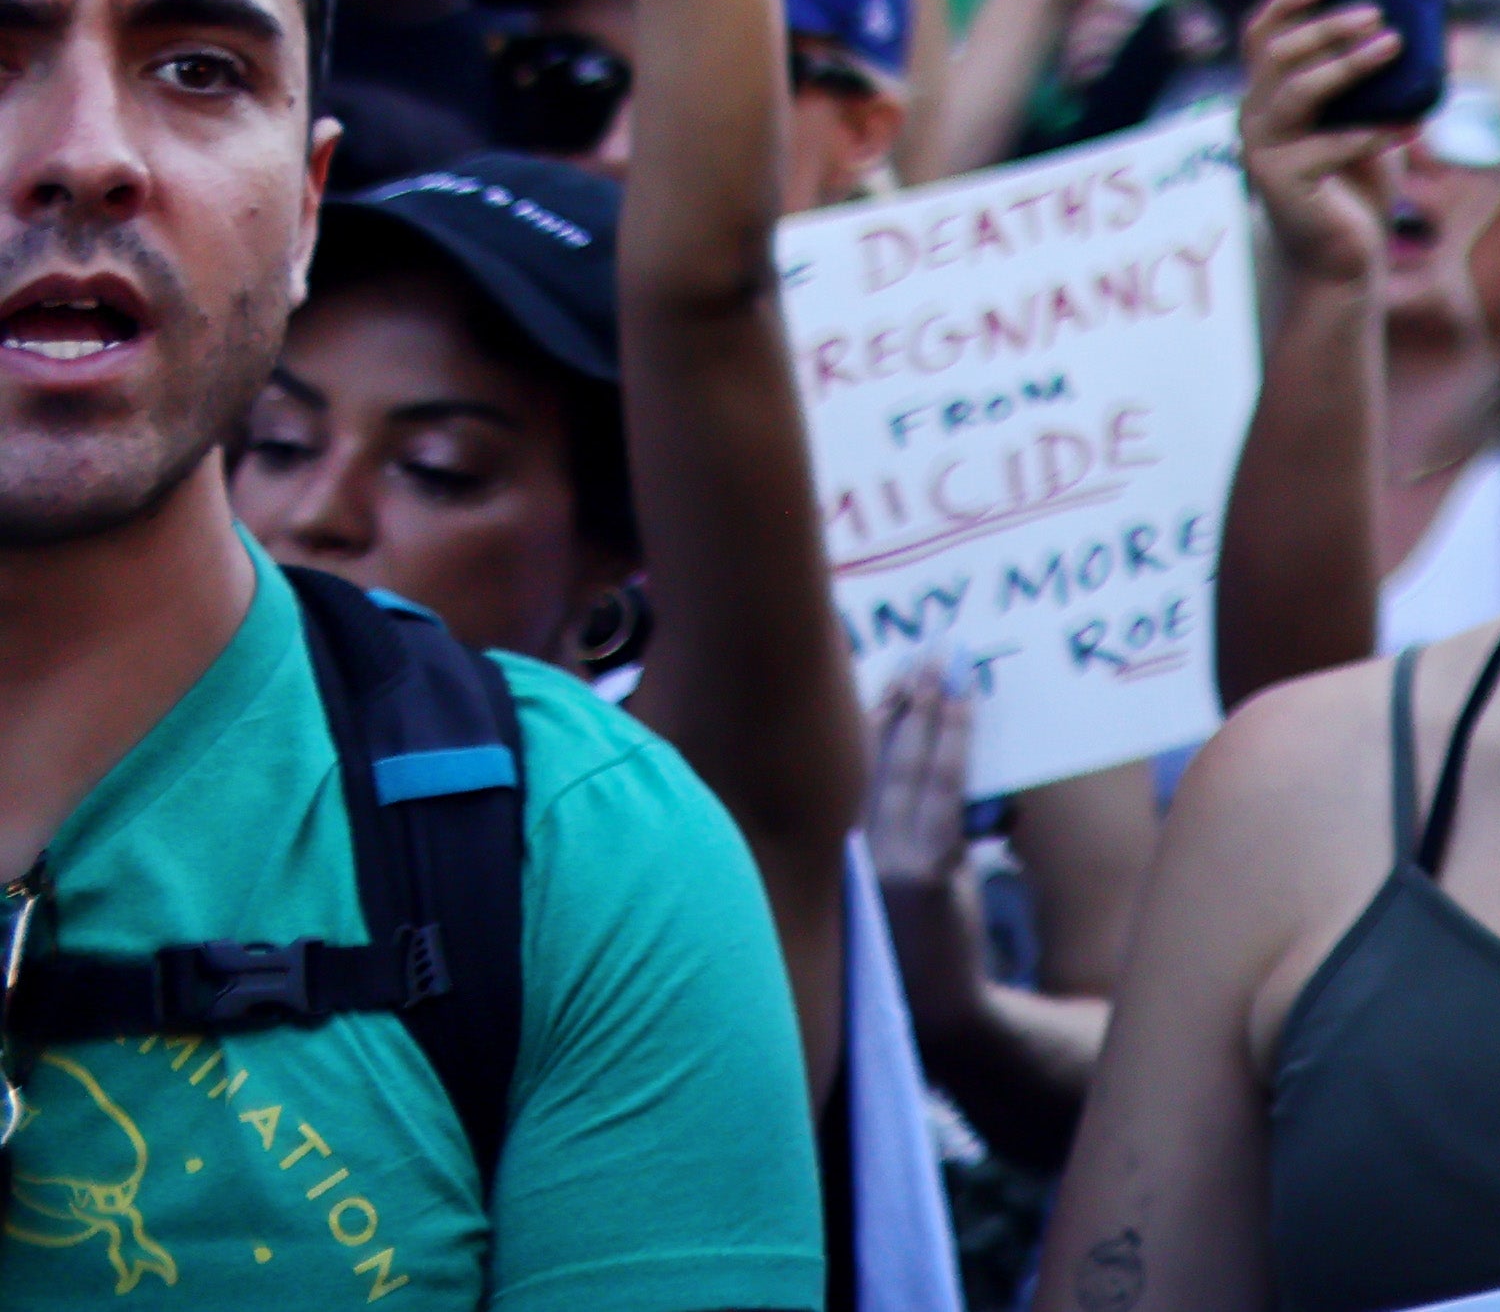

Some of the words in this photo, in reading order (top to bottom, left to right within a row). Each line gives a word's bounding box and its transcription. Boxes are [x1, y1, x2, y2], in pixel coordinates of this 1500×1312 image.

[859, 166, 1152, 295] DEATHS
[888, 372, 1075, 449] FROM
[997, 512, 1213, 609] MORE
[1066, 594, 1198, 673] ROE
